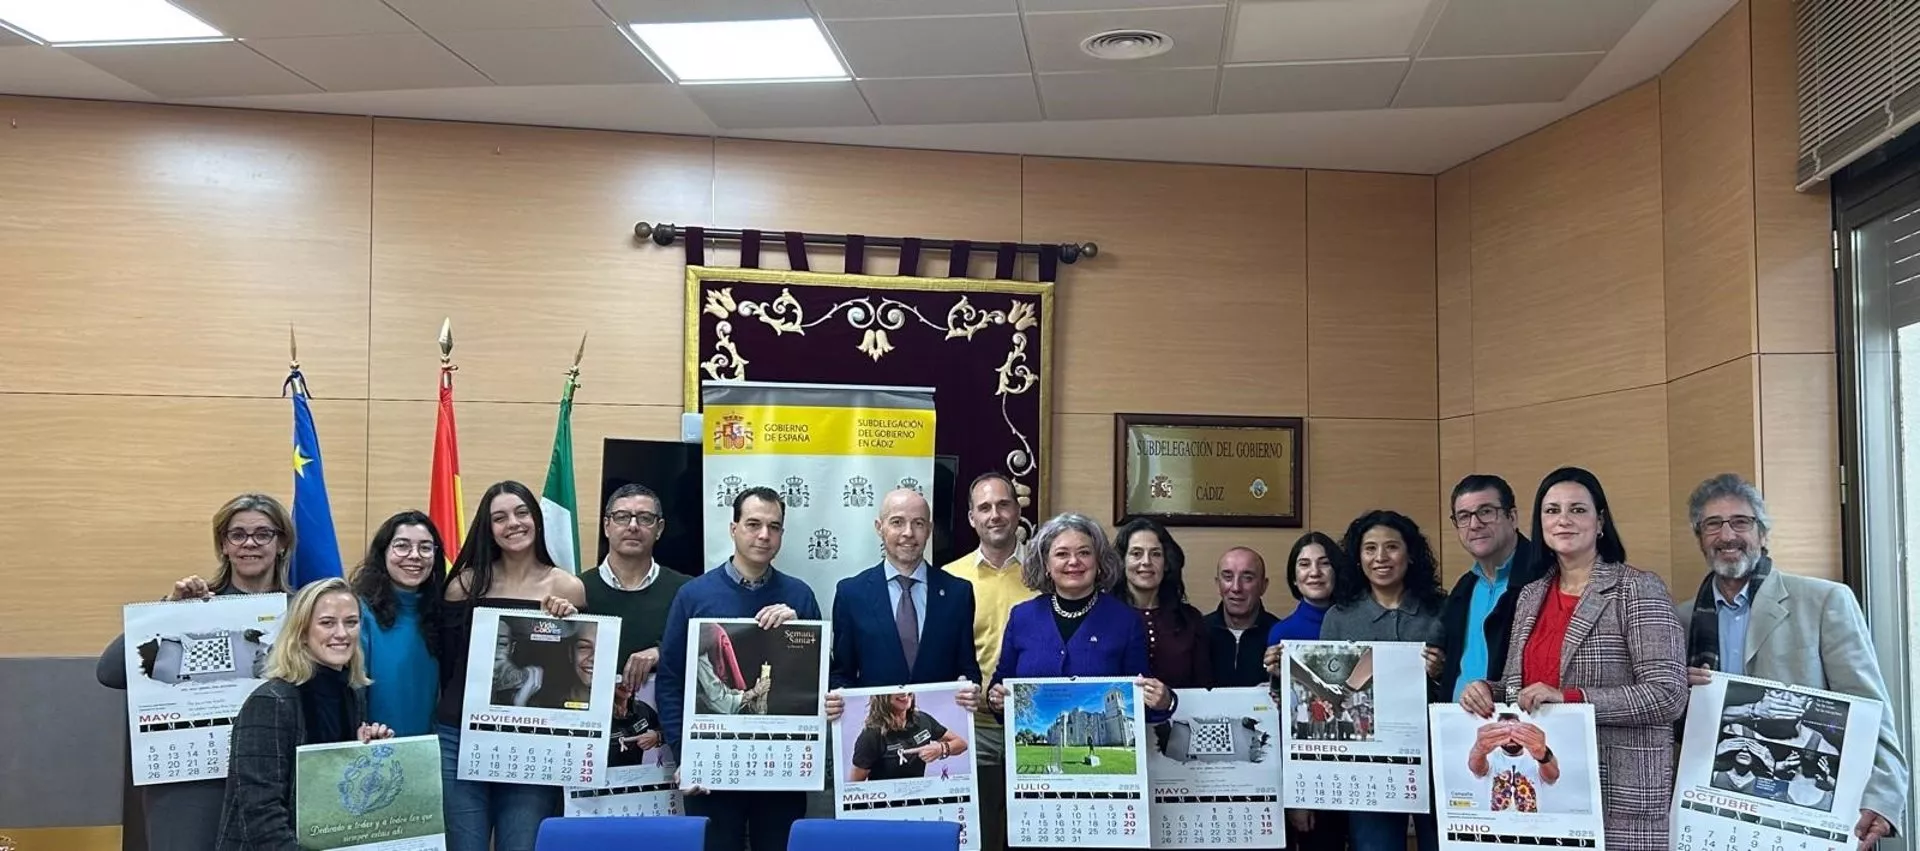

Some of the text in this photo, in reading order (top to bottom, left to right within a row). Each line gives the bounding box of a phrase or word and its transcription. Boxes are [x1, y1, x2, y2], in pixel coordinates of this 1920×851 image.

[764, 424, 809, 433] GOBIERNO
[858, 419, 923, 429] SUBDELEGACIÓN
[764, 433, 810, 443] DE ESPAÑA
[874, 430, 915, 438] GOBIERNO
[870, 439, 894, 448] CÁDIZ
[1137, 438, 1282, 459] SUBDELEGACIÓN DEL GOBIERNO
[1196, 482, 1224, 500] CÁDIZ
[140, 712, 180, 722] MAYO
[470, 714, 549, 725] NOVIEMBRE
[1290, 744, 1348, 753] FEBRERO
[843, 792, 887, 802] MARZO
[1684, 790, 1758, 813] OCTUBRE
[1447, 824, 1490, 833] JUNIO
[1820, 820, 1850, 831] 2025
[309, 825, 345, 837] Dedicado
[1579, 839, 1586, 847] D
[1729, 835, 1736, 843] 8
